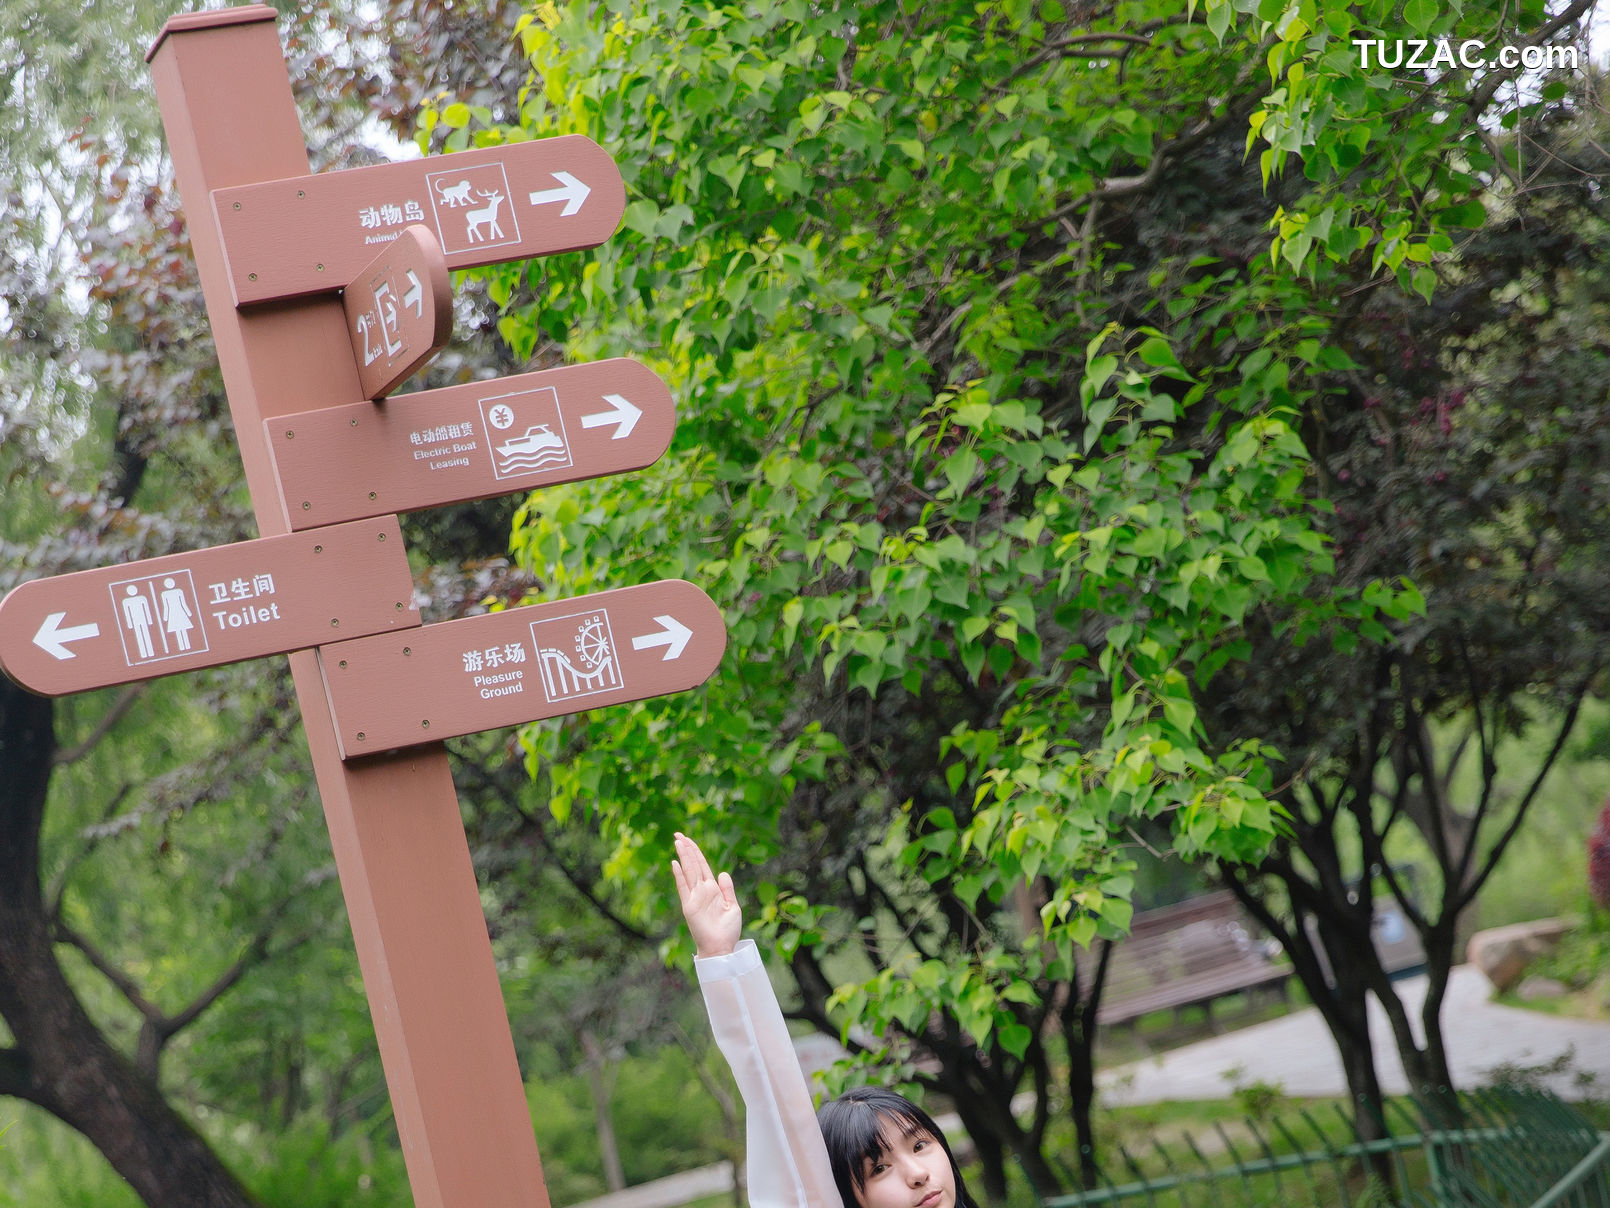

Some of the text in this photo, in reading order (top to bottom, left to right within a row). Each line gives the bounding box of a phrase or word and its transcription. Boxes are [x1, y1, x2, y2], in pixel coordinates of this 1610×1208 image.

[359, 200, 425, 229] 动物岛
[410, 422, 474, 445] 电动船租赁
[414, 441, 477, 460] Electric Boat
[430, 457, 470, 470] Leasing
[208, 573, 276, 604] 卫生间
[212, 602, 281, 630] Toilet
[462, 642, 526, 672] 游乐场
[474, 670, 523, 687] Pleasure
[480, 681, 523, 699] Ground
